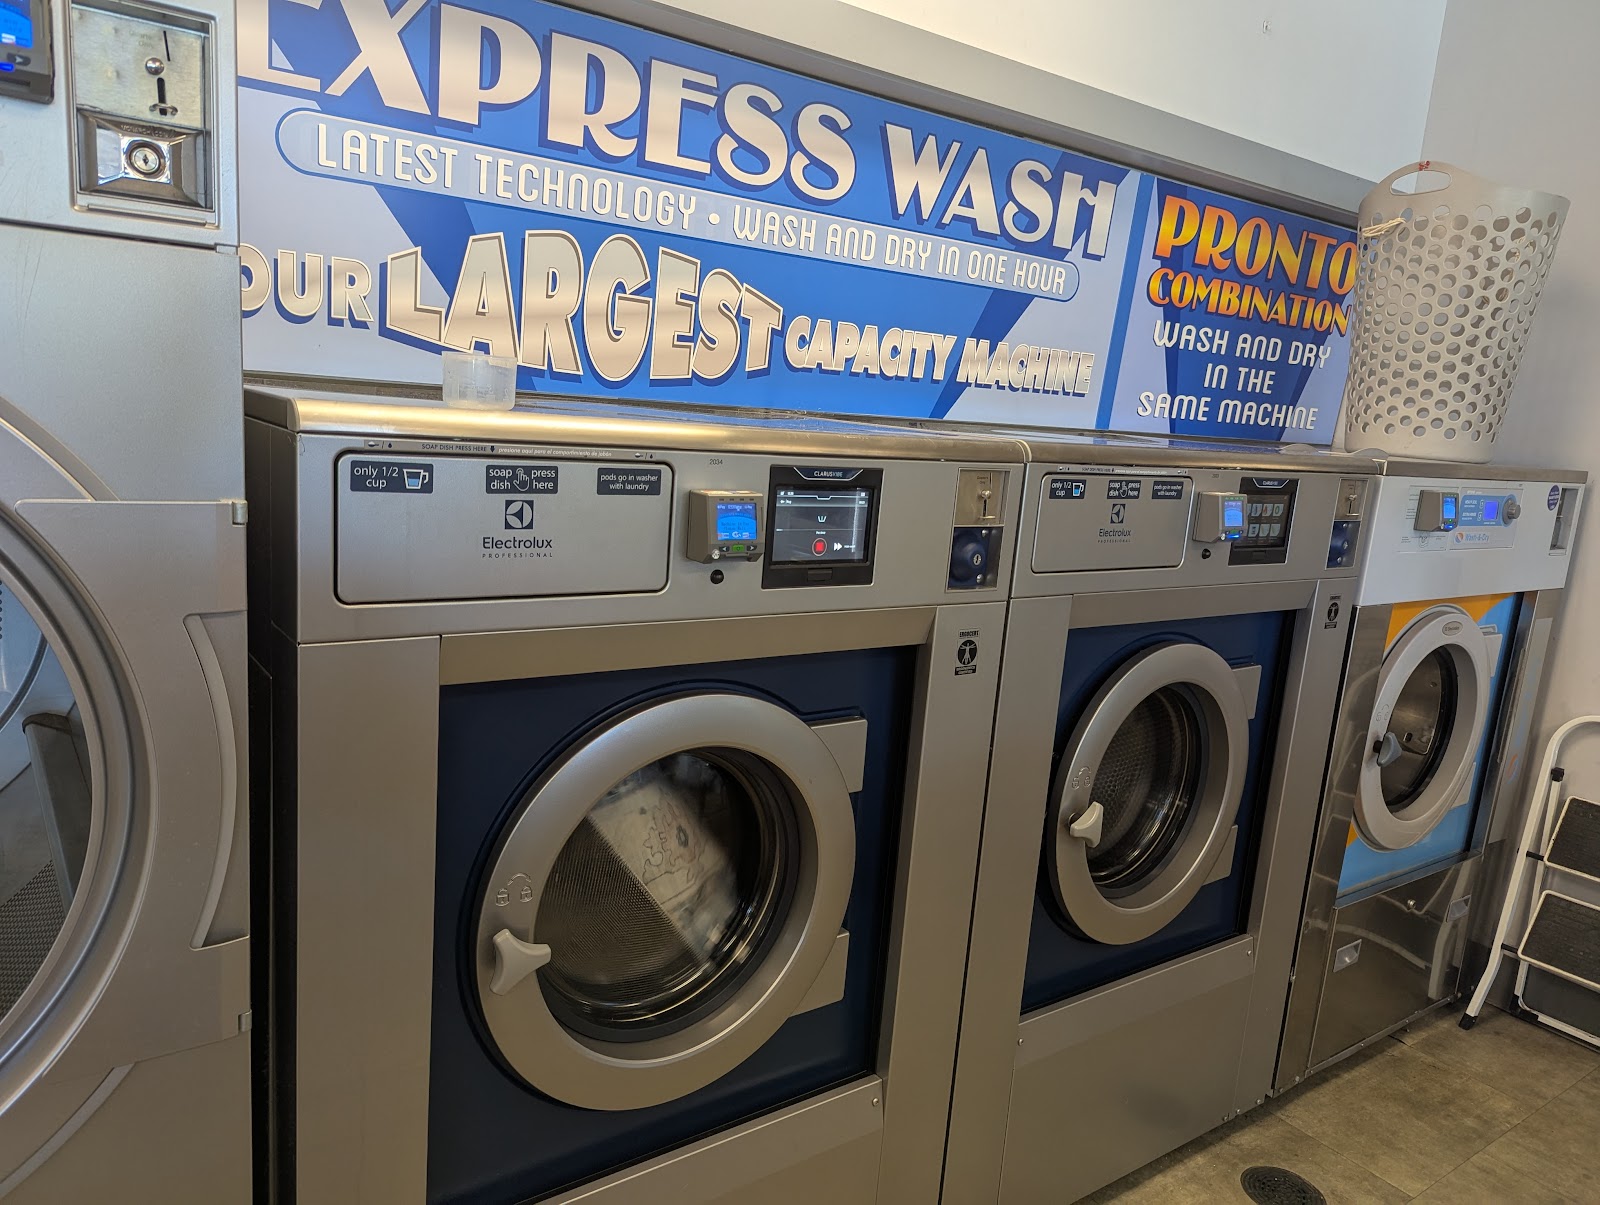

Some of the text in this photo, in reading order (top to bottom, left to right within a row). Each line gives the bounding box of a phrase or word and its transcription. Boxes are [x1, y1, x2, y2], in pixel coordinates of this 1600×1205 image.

[238, 0, 1117, 258] EXPRESS WASH
[317, 123, 1067, 296] LATEST TECHNOLOGY WASH AND DRY IN ONE HOUR
[1154, 194, 1358, 297] PRONTO
[1148, 267, 1352, 337] COMBINATION
[239, 229, 1096, 395] OUR LARGEST CAPACITY MACHINE
[1153, 320, 1332, 369] WASH AND DRY
[1203, 363, 1276, 395] IN THE
[1137, 391, 1319, 430] SAME MACHINE
[709, 458, 723, 466] 2034
[354, 465, 399, 479] only 1/2
[489, 468, 513, 479] soap
[531, 469, 556, 480] press
[600, 473, 617, 482] pods
[618, 475, 627, 483] go
[636, 474, 659, 482] washer
[366, 479, 387, 490] cup
[490, 479, 511, 490] dish
[532, 479, 554, 490] here
[609, 482, 650, 492] with laundry
[1051, 481, 1063, 490] only
[1109, 482, 1121, 490] soap
[1128, 482, 1141, 490] press
[1098, 528, 1132, 538] Electrolux
[482, 536, 553, 549] Electrolux
